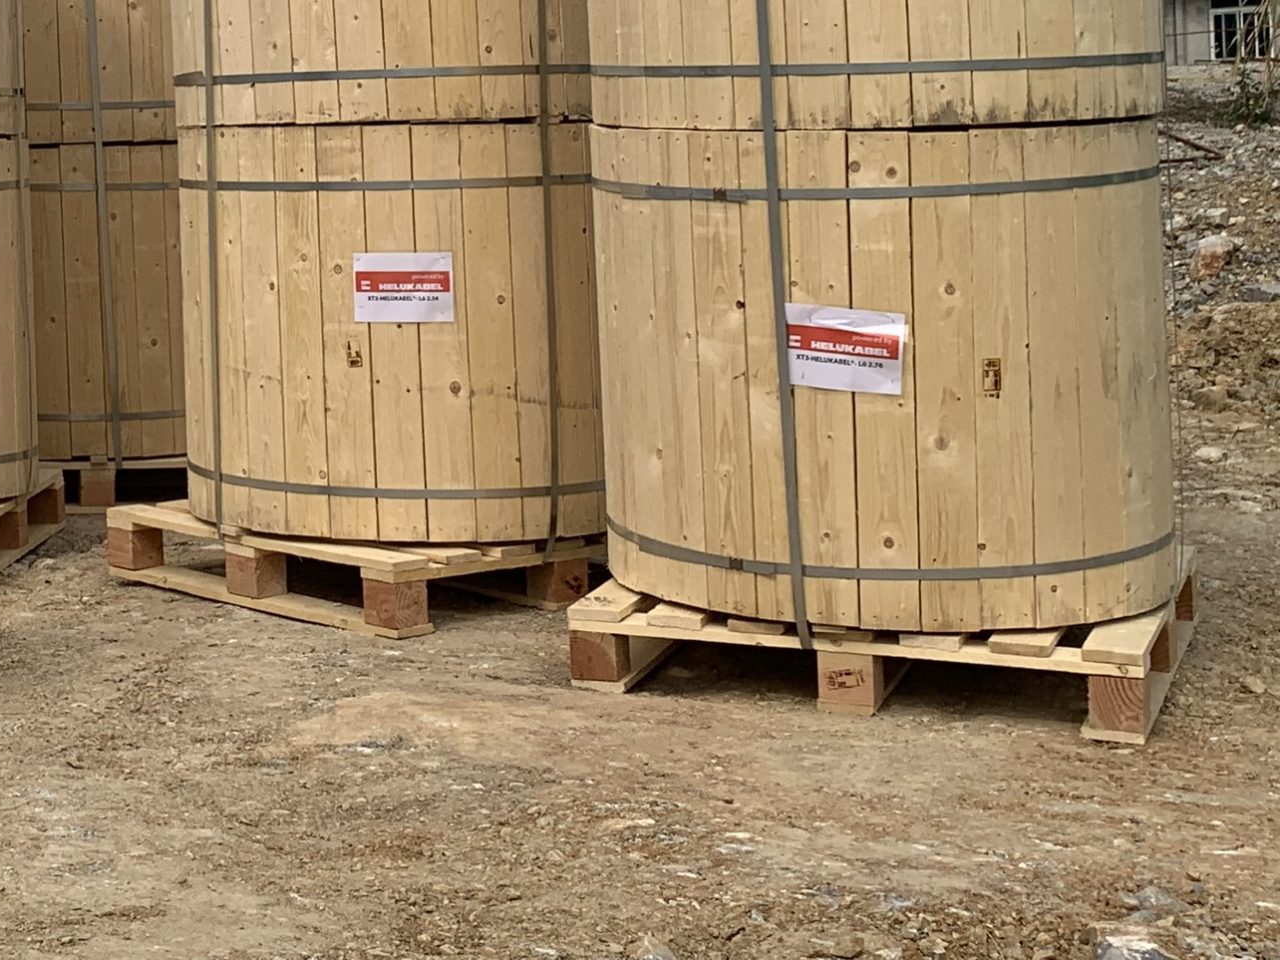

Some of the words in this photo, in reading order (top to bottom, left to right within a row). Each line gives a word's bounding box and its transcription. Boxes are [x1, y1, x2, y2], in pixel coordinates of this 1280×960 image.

[378, 283, 444, 291] HELUKABEL
[851, 335, 882, 344] powered
[810, 340, 891, 357] HELUKABEL
